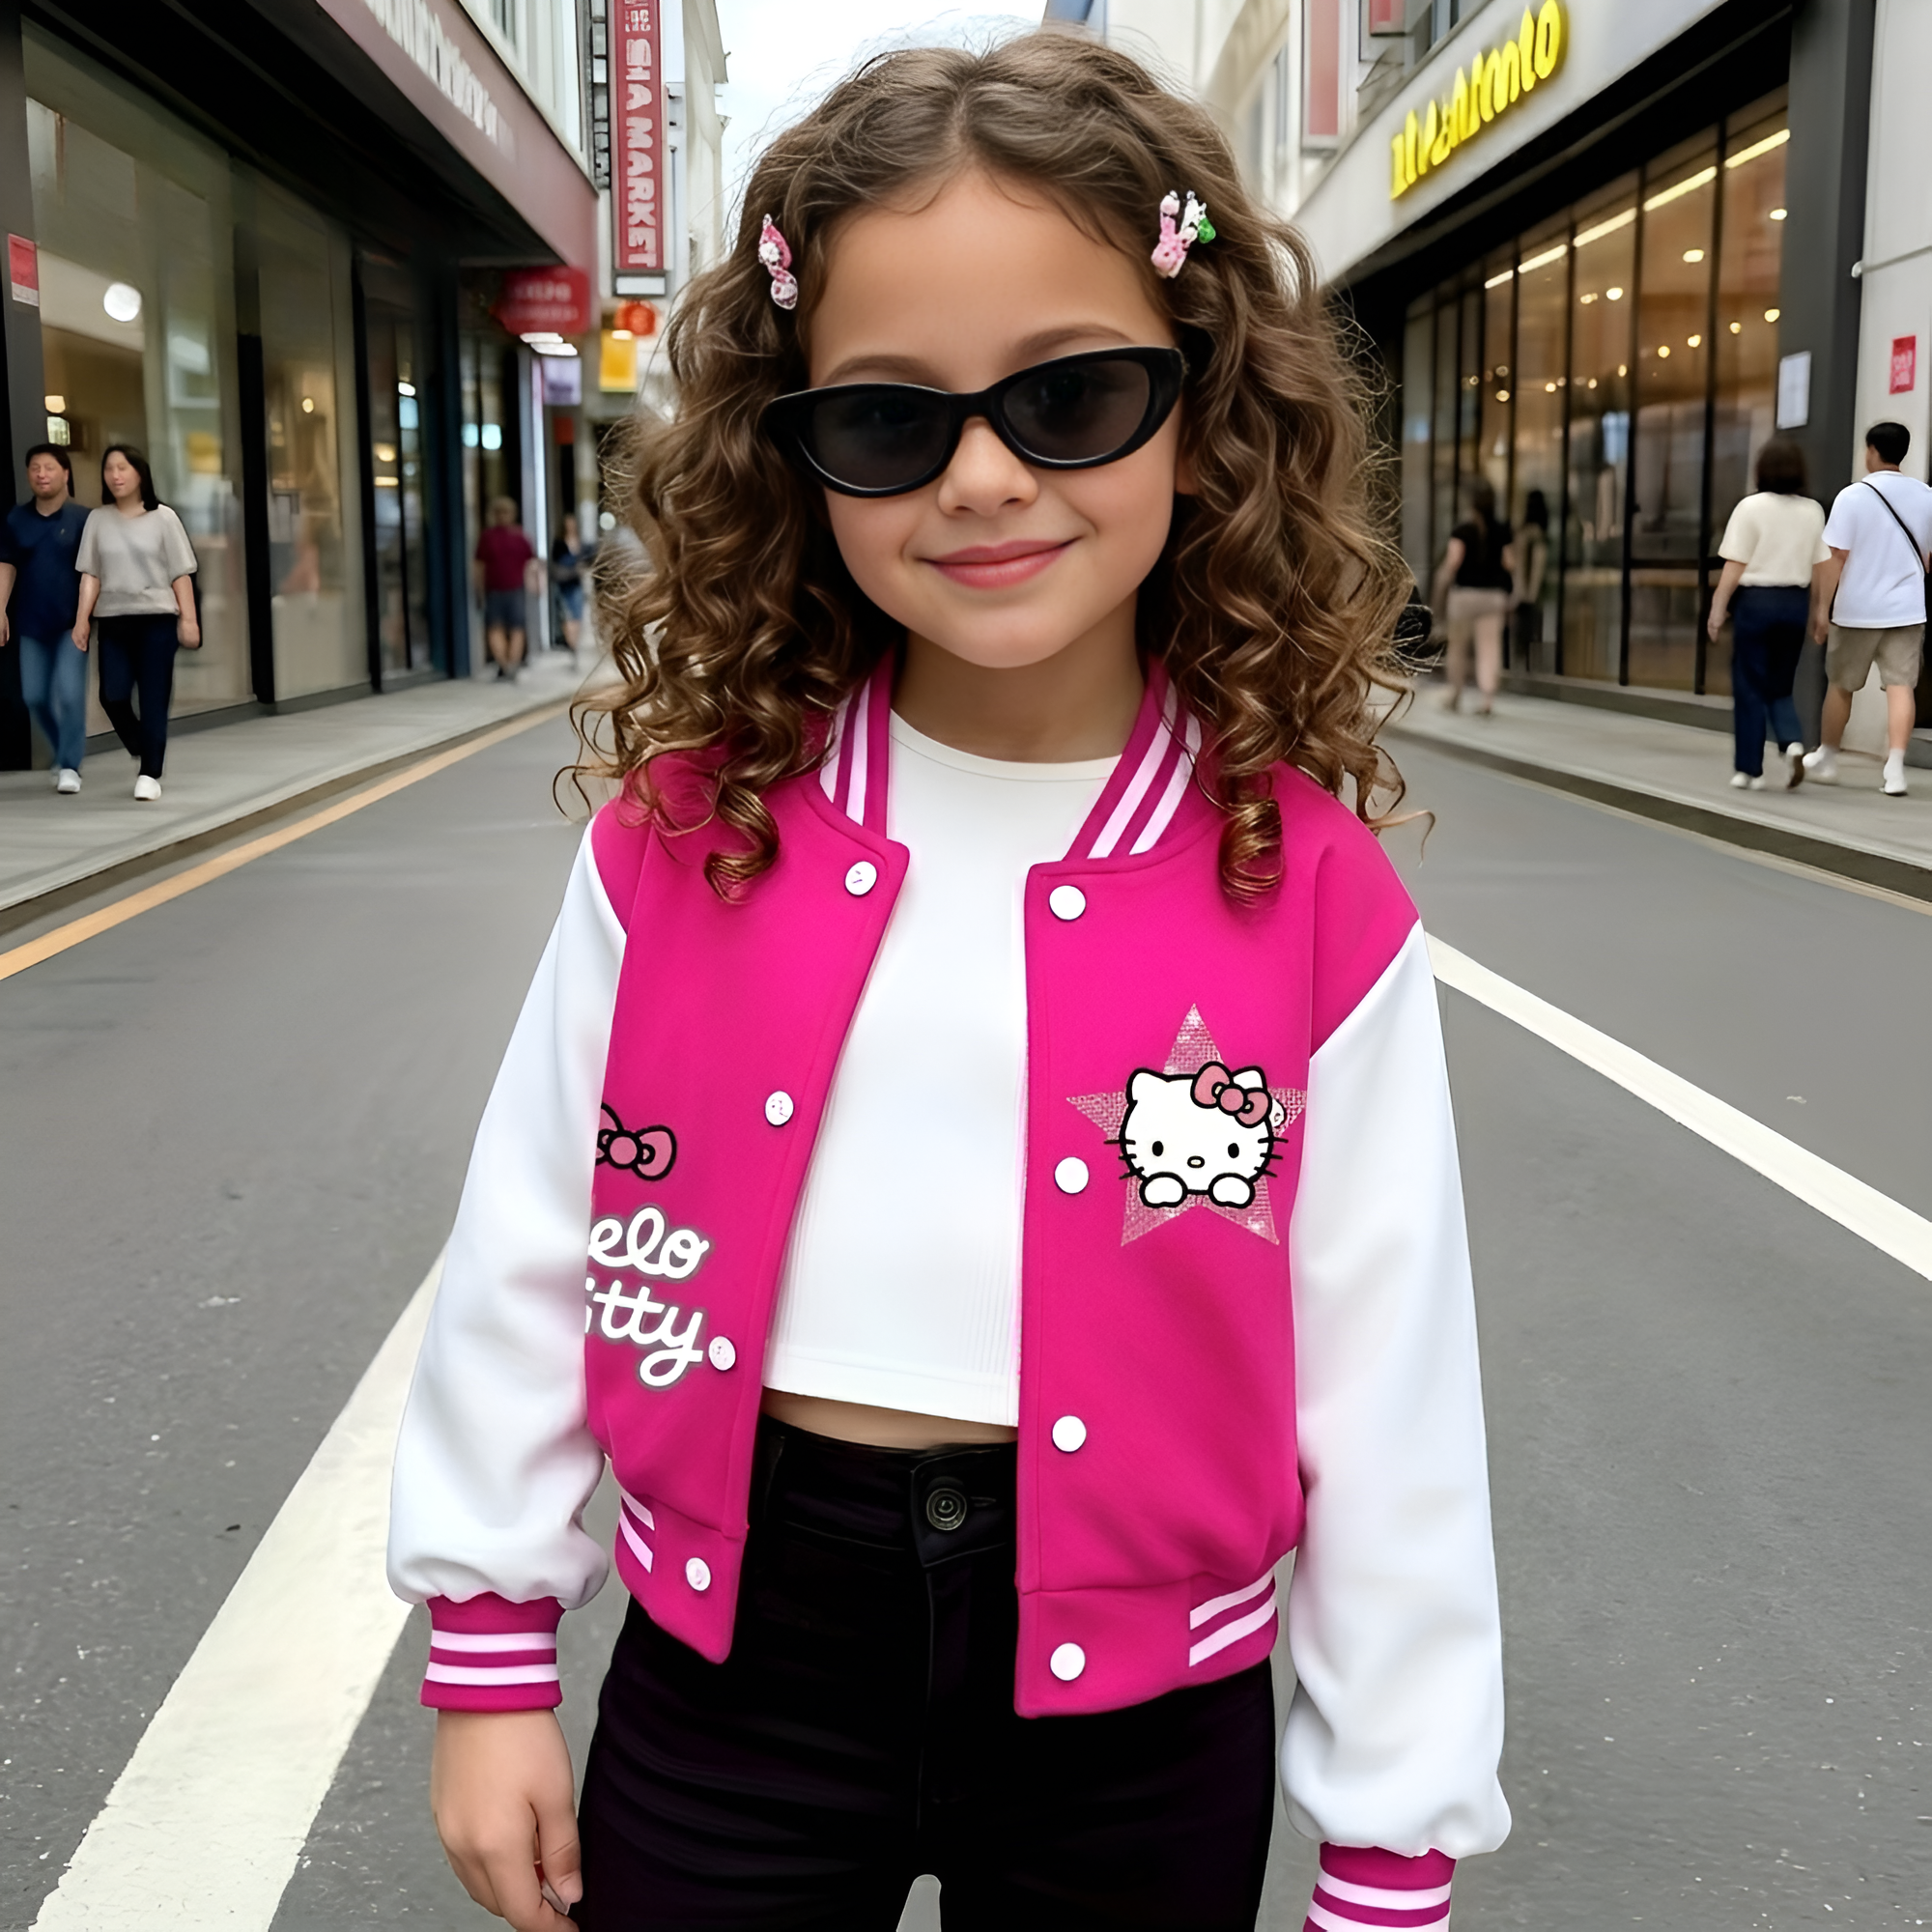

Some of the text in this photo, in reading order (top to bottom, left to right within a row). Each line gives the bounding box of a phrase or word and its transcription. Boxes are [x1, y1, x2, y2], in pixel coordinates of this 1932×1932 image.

[626, 117, 657, 268] MARKET
[587, 1207, 710, 1279] elo
[584, 1277, 703, 1387] itty
